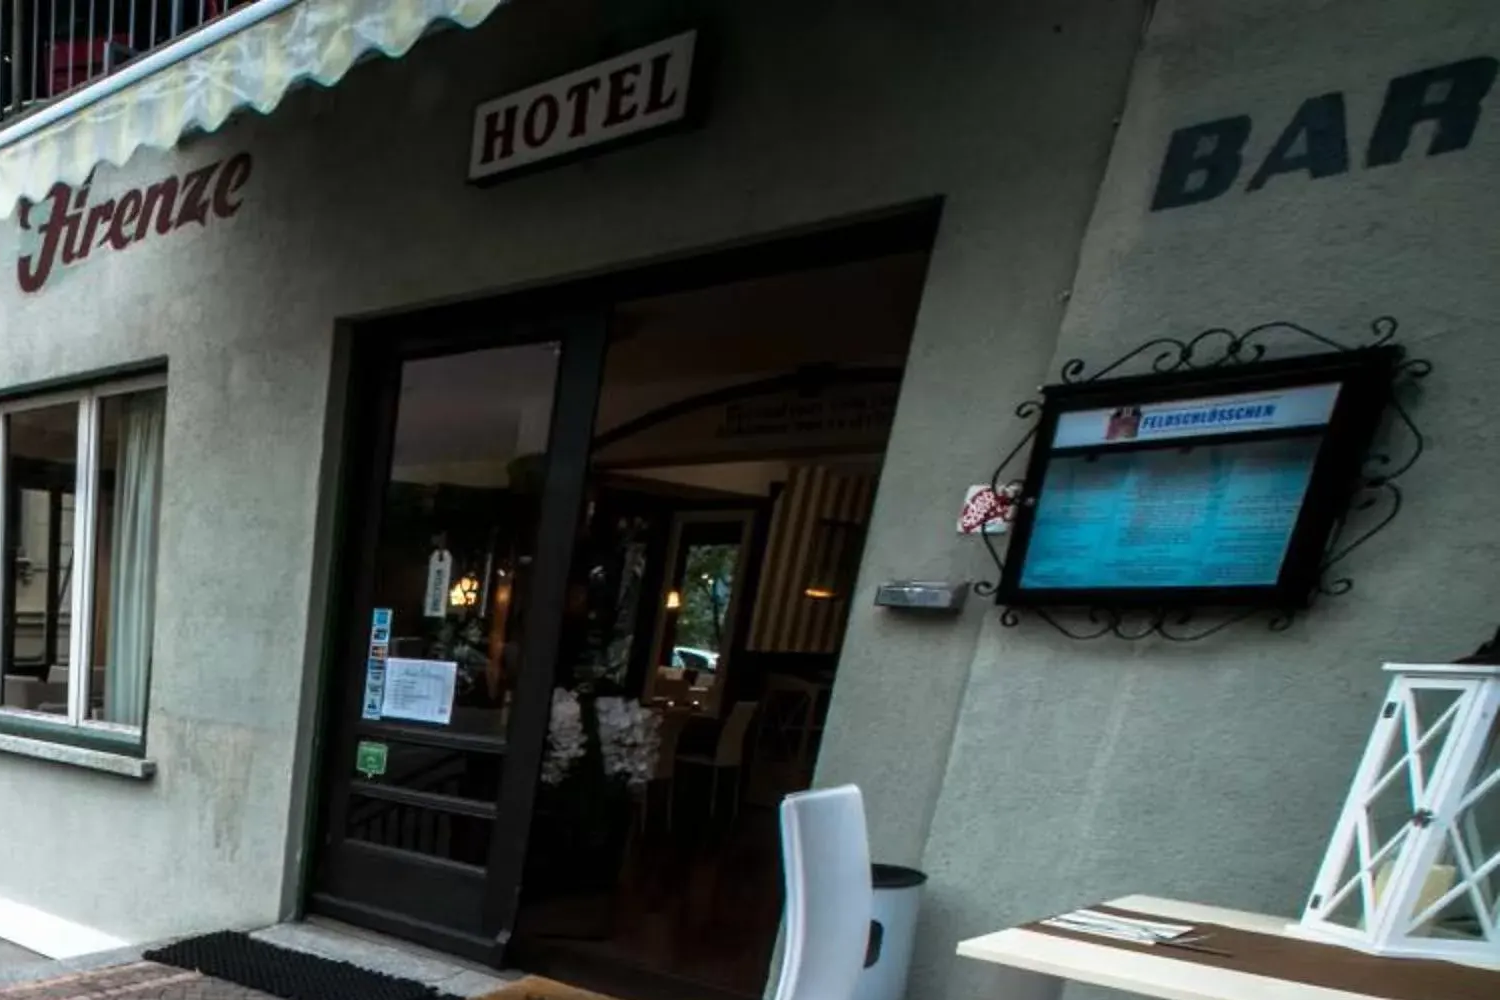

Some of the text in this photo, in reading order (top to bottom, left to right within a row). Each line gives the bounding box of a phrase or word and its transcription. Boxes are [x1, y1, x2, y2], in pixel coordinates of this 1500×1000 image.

[480, 50, 677, 165] HOTEL
[1150, 56, 1499, 211] BAR
[17, 152, 253, 292] Firenze
[1142, 404, 1276, 428] FELDSCHLÖSSCHEN
